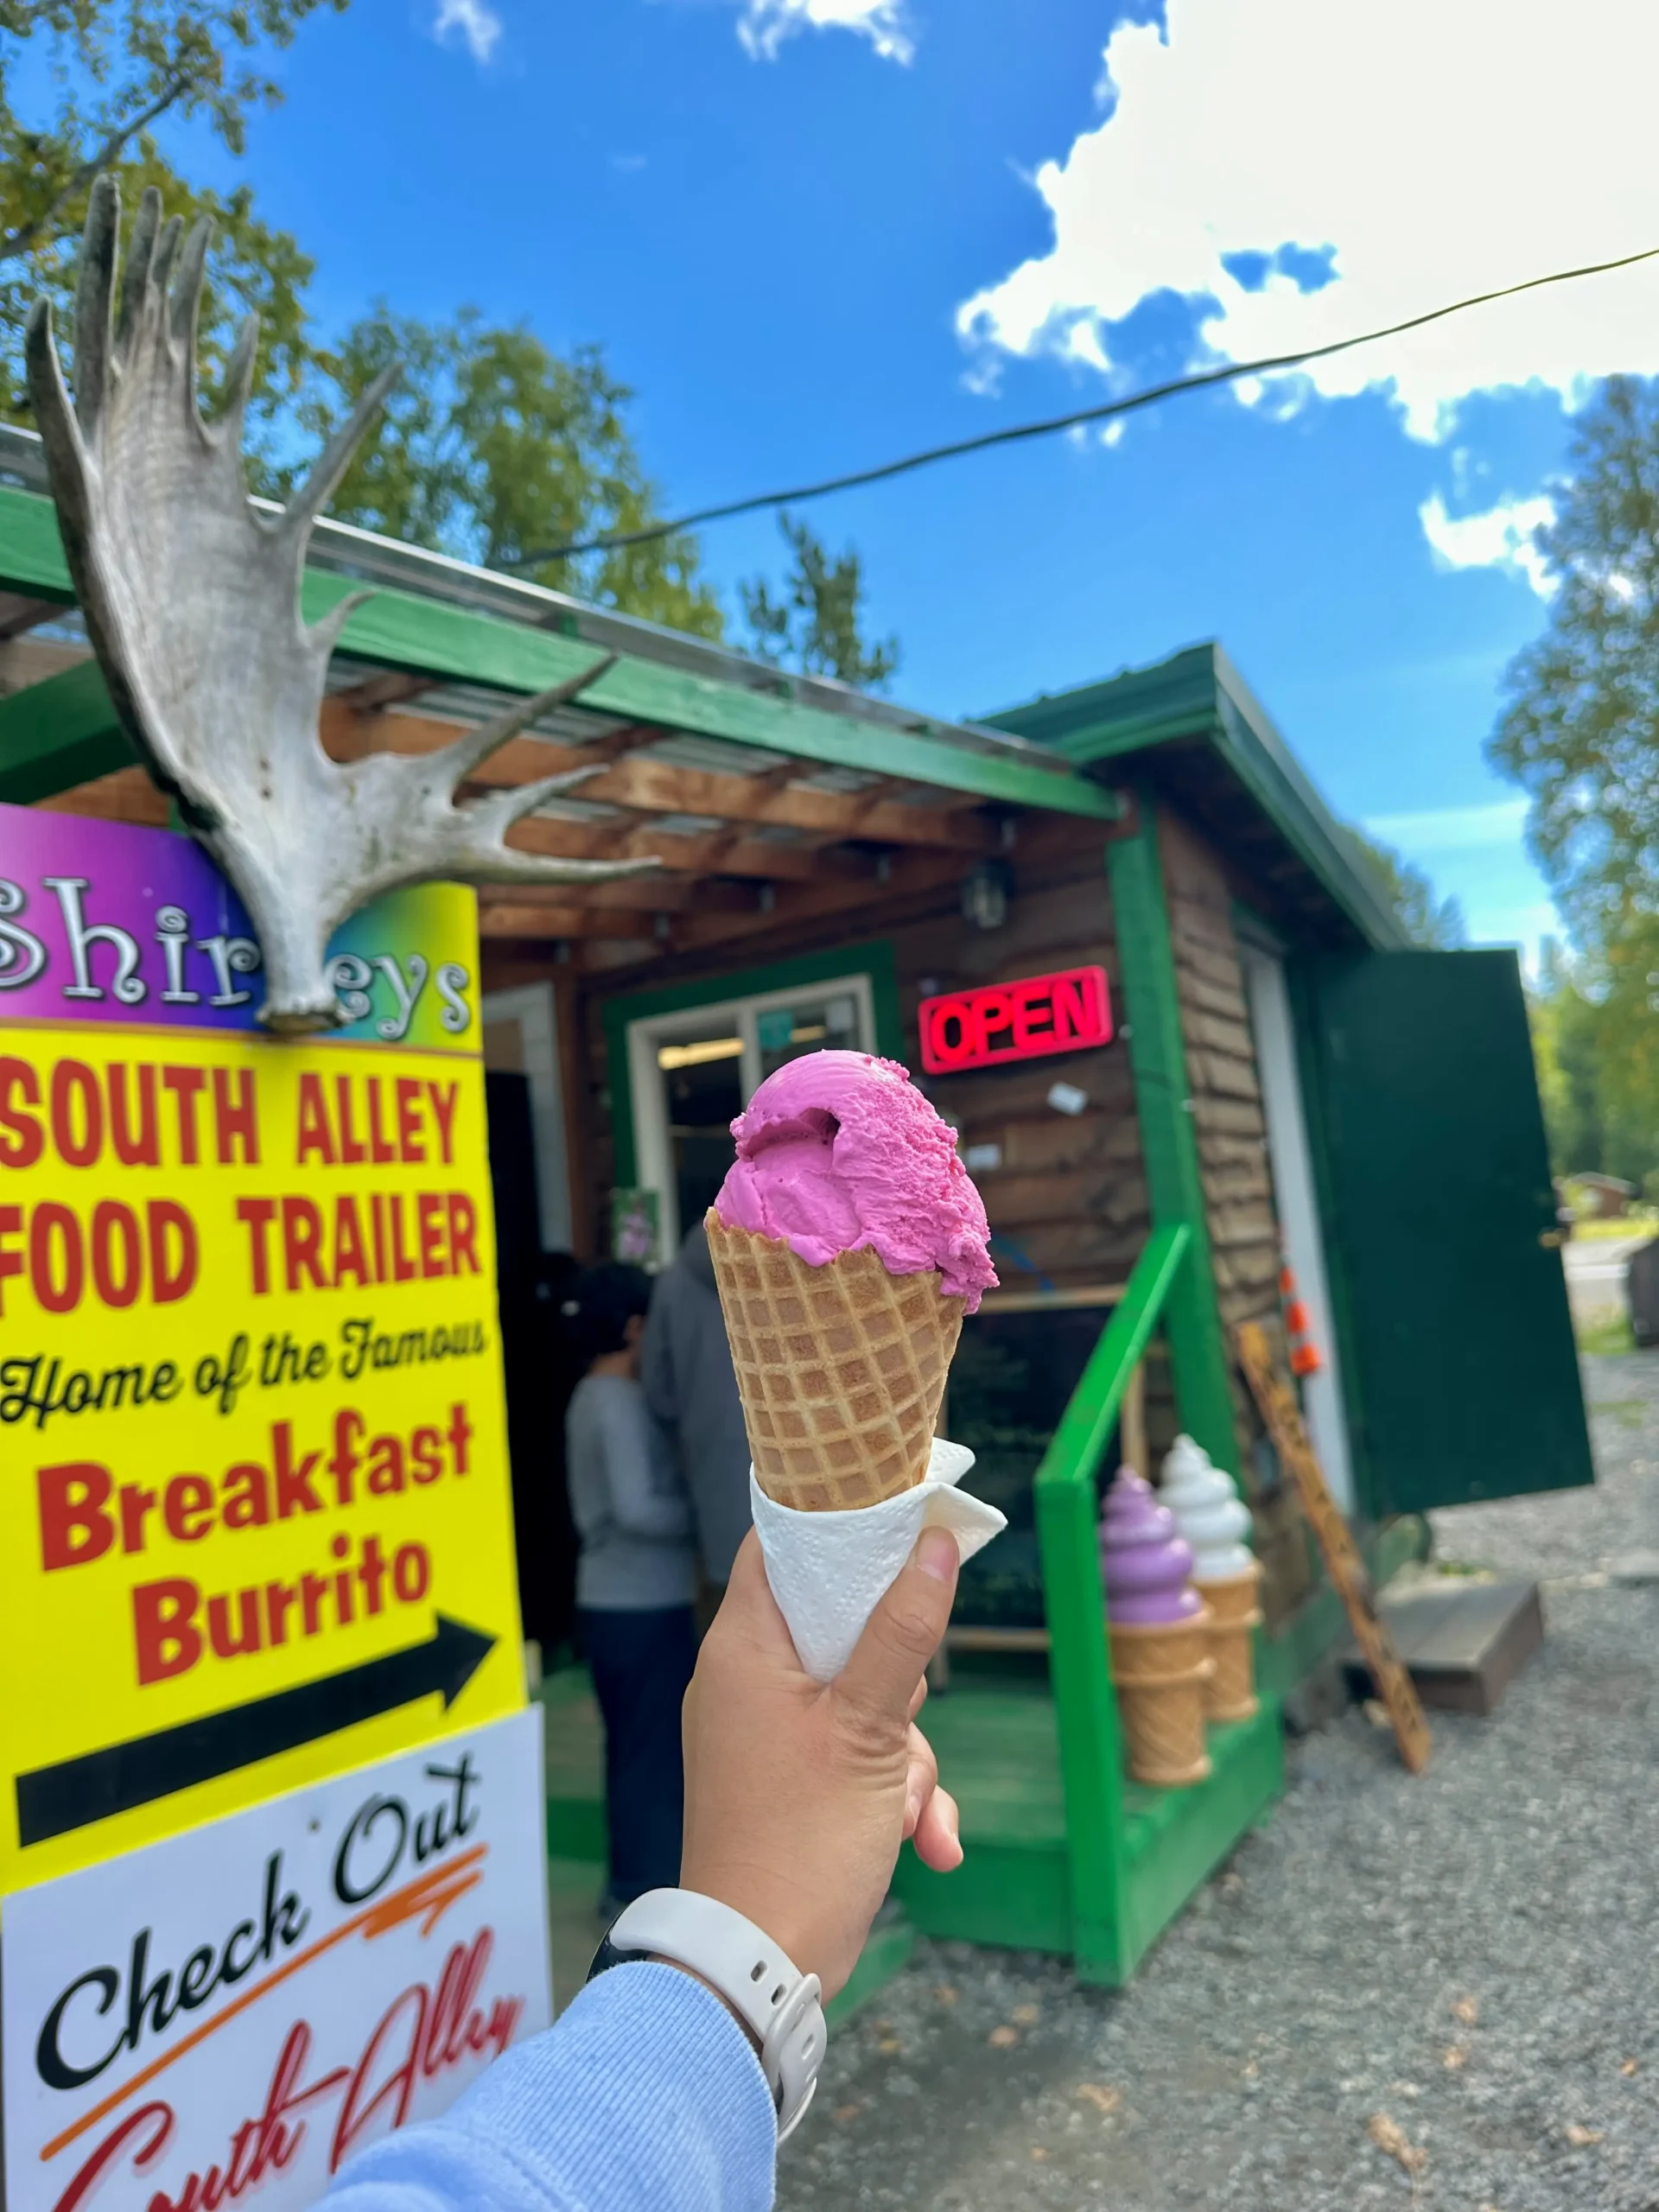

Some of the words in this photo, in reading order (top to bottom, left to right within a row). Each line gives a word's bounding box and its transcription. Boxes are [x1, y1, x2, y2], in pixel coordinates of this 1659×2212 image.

[0, 877, 471, 1040] Shireys
[931, 977, 1100, 1065] OPEN
[0, 1055, 260, 1169] SOUTH
[296, 1071, 459, 1166] ALLEY
[235, 1190, 482, 1296] TRAILER
[0, 1354, 179, 1430] Home
[194, 1332, 251, 1417] of
[259, 1332, 331, 1386] the
[340, 1317, 487, 1380] Famous
[36, 1400, 473, 1573] Breakfast
[131, 1532, 431, 1688] Burrito
[35, 1847, 311, 2090] Check
[333, 1751, 480, 1904] Out
